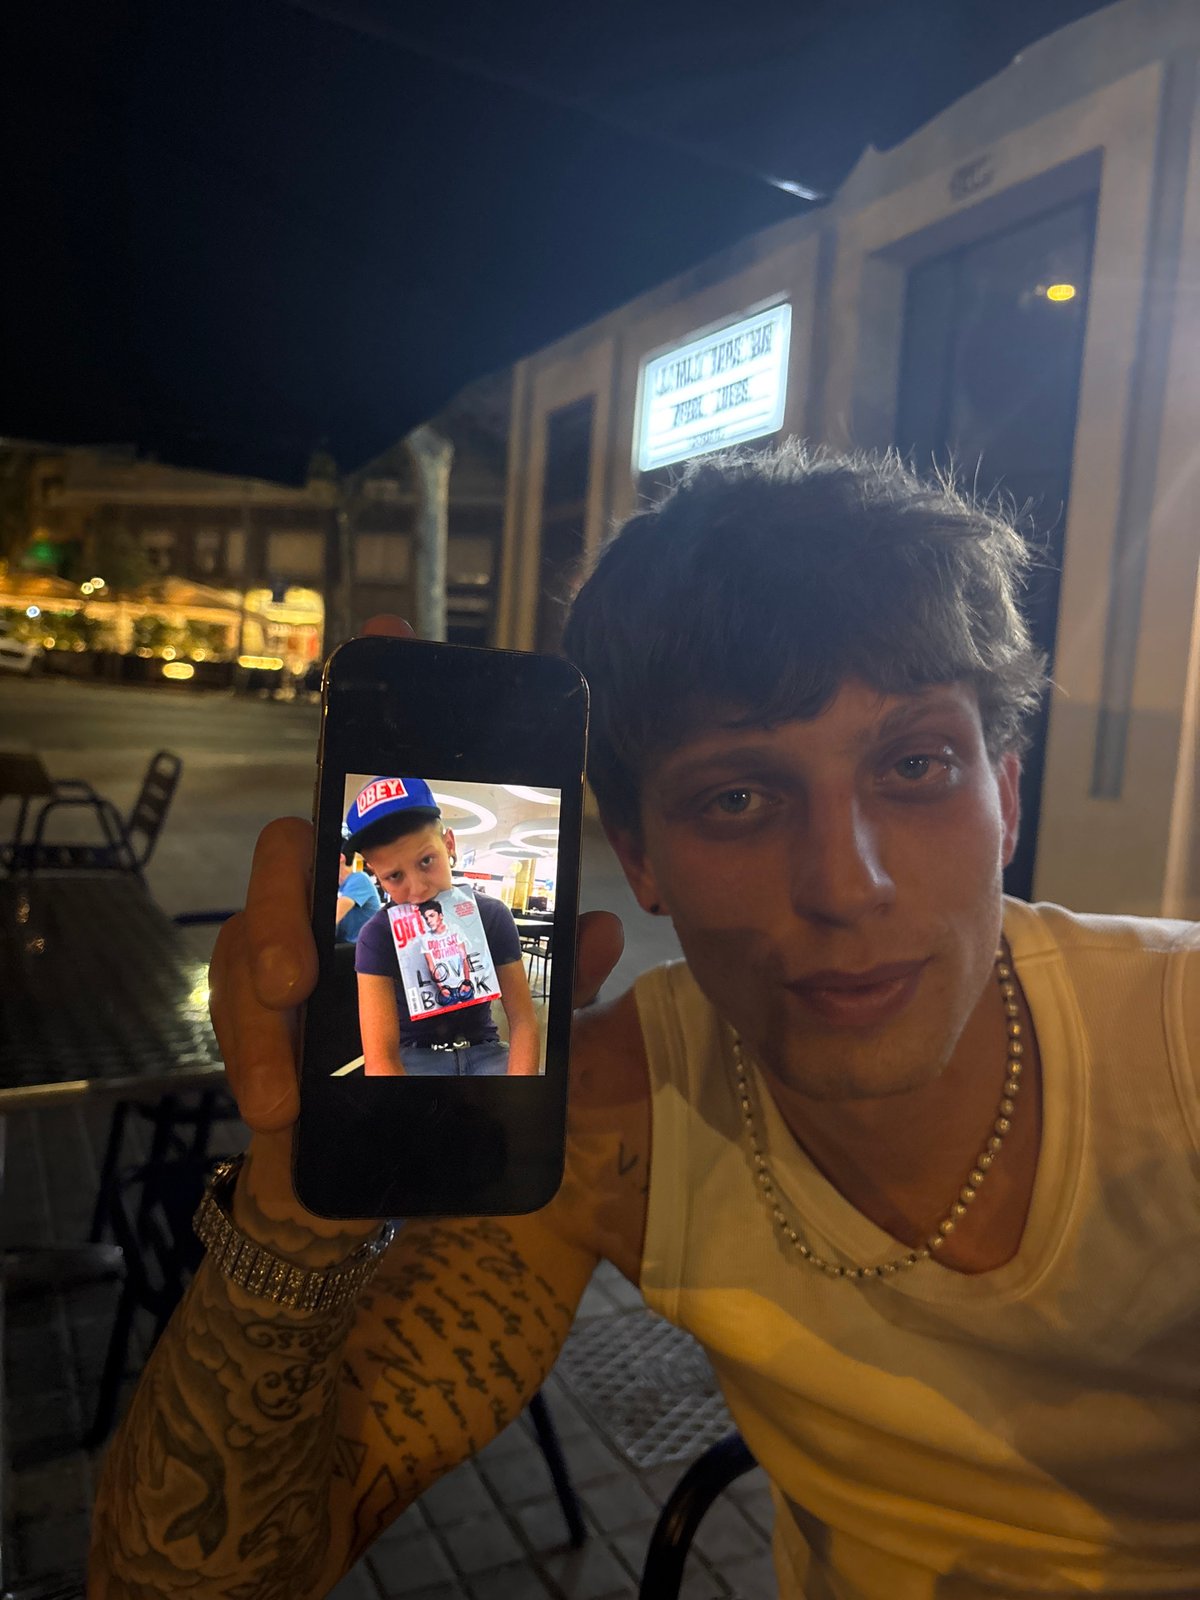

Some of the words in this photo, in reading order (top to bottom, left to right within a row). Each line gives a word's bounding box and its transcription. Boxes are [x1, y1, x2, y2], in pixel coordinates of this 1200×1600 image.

[359, 779, 399, 811] OBEY
[393, 908, 426, 948] girl
[446, 933, 459, 946] SAY
[417, 952, 484, 988] LOVE
